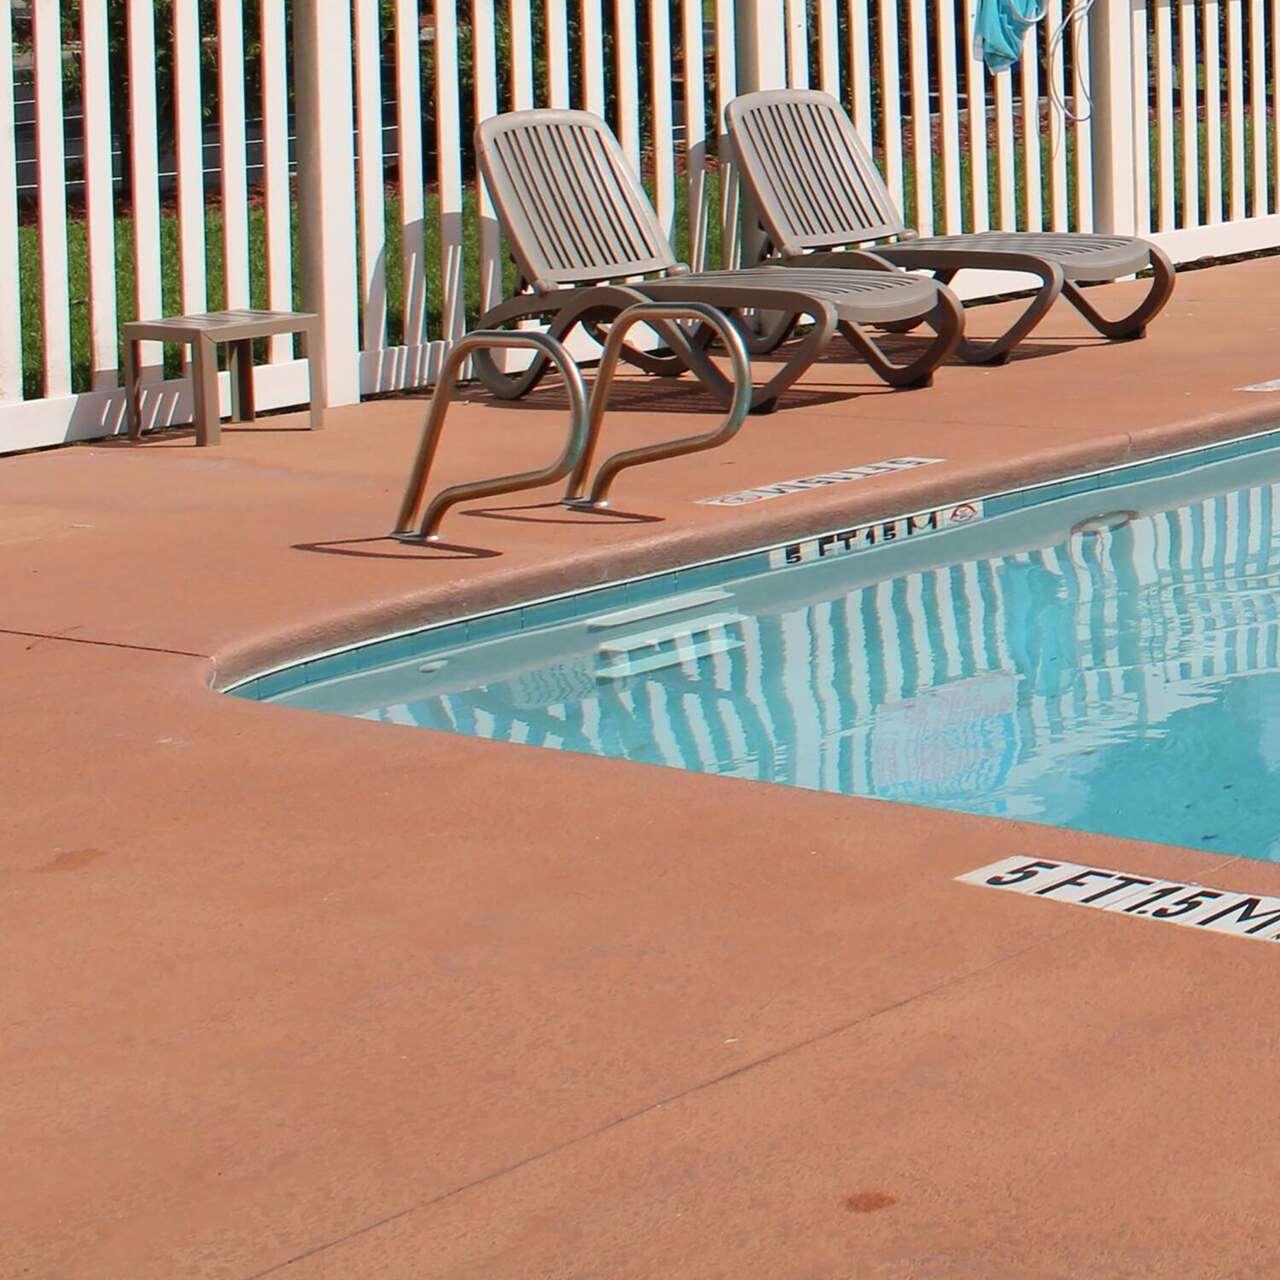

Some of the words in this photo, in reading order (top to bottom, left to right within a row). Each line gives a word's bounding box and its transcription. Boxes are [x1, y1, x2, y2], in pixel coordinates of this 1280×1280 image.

[785, 543, 802, 564] 5
[818, 530, 858, 557] FT
[907, 511, 938, 535] M
[986, 861, 1060, 886] 5
[1035, 870, 1154, 903] FT
